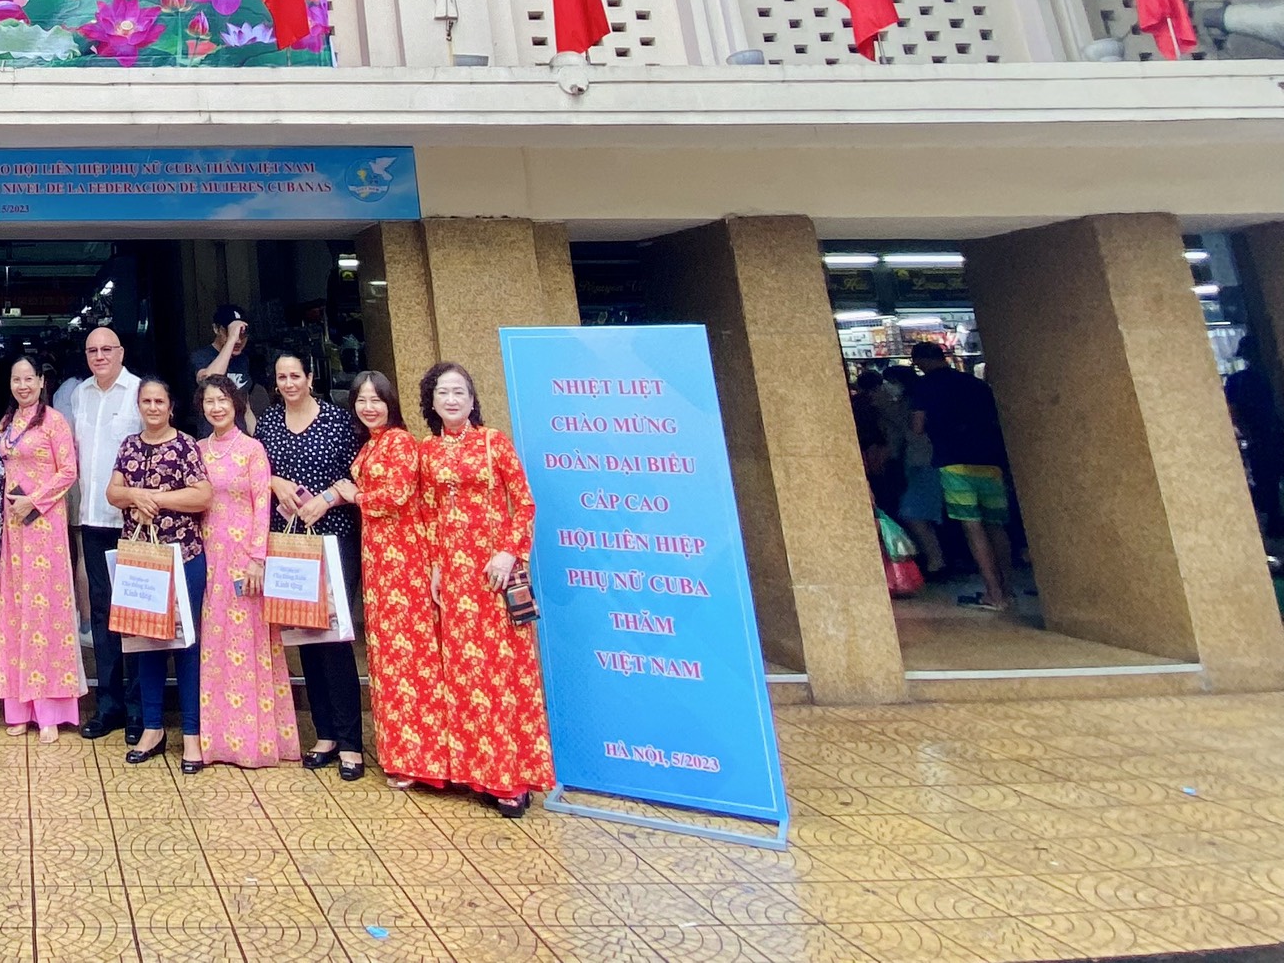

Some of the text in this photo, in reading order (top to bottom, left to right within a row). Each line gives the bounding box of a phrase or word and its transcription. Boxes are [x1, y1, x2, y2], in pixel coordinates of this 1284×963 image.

[166, 163, 202, 173] CUBA
[283, 162, 315, 173] NAM
[3, 182, 45, 194] NIVEL
[47, 182, 65, 194] DE
[68, 182, 86, 194] LA
[180, 181, 199, 193] DE
[202, 181, 264, 193] MUJERES
[268, 181, 332, 193] CUBANAS
[2, 205, 29, 214] 5/2023
[552, 378, 663, 398] NHIỆT LIỆT
[551, 412, 676, 434] CHÀO MỪNG
[545, 450, 600, 470] ĐOÀN
[605, 455, 641, 474] ĐẠI
[625, 495, 669, 512] CAO
[559, 529, 705, 557] HỘI LIÊN HIỆP
[568, 569, 709, 596] PHỤ NỮ CUBA
[610, 611, 673, 634] THĂM
[596, 651, 701, 678] VIỆT NAM
[606, 741, 719, 771] HÀ NỘI, 5/2023
